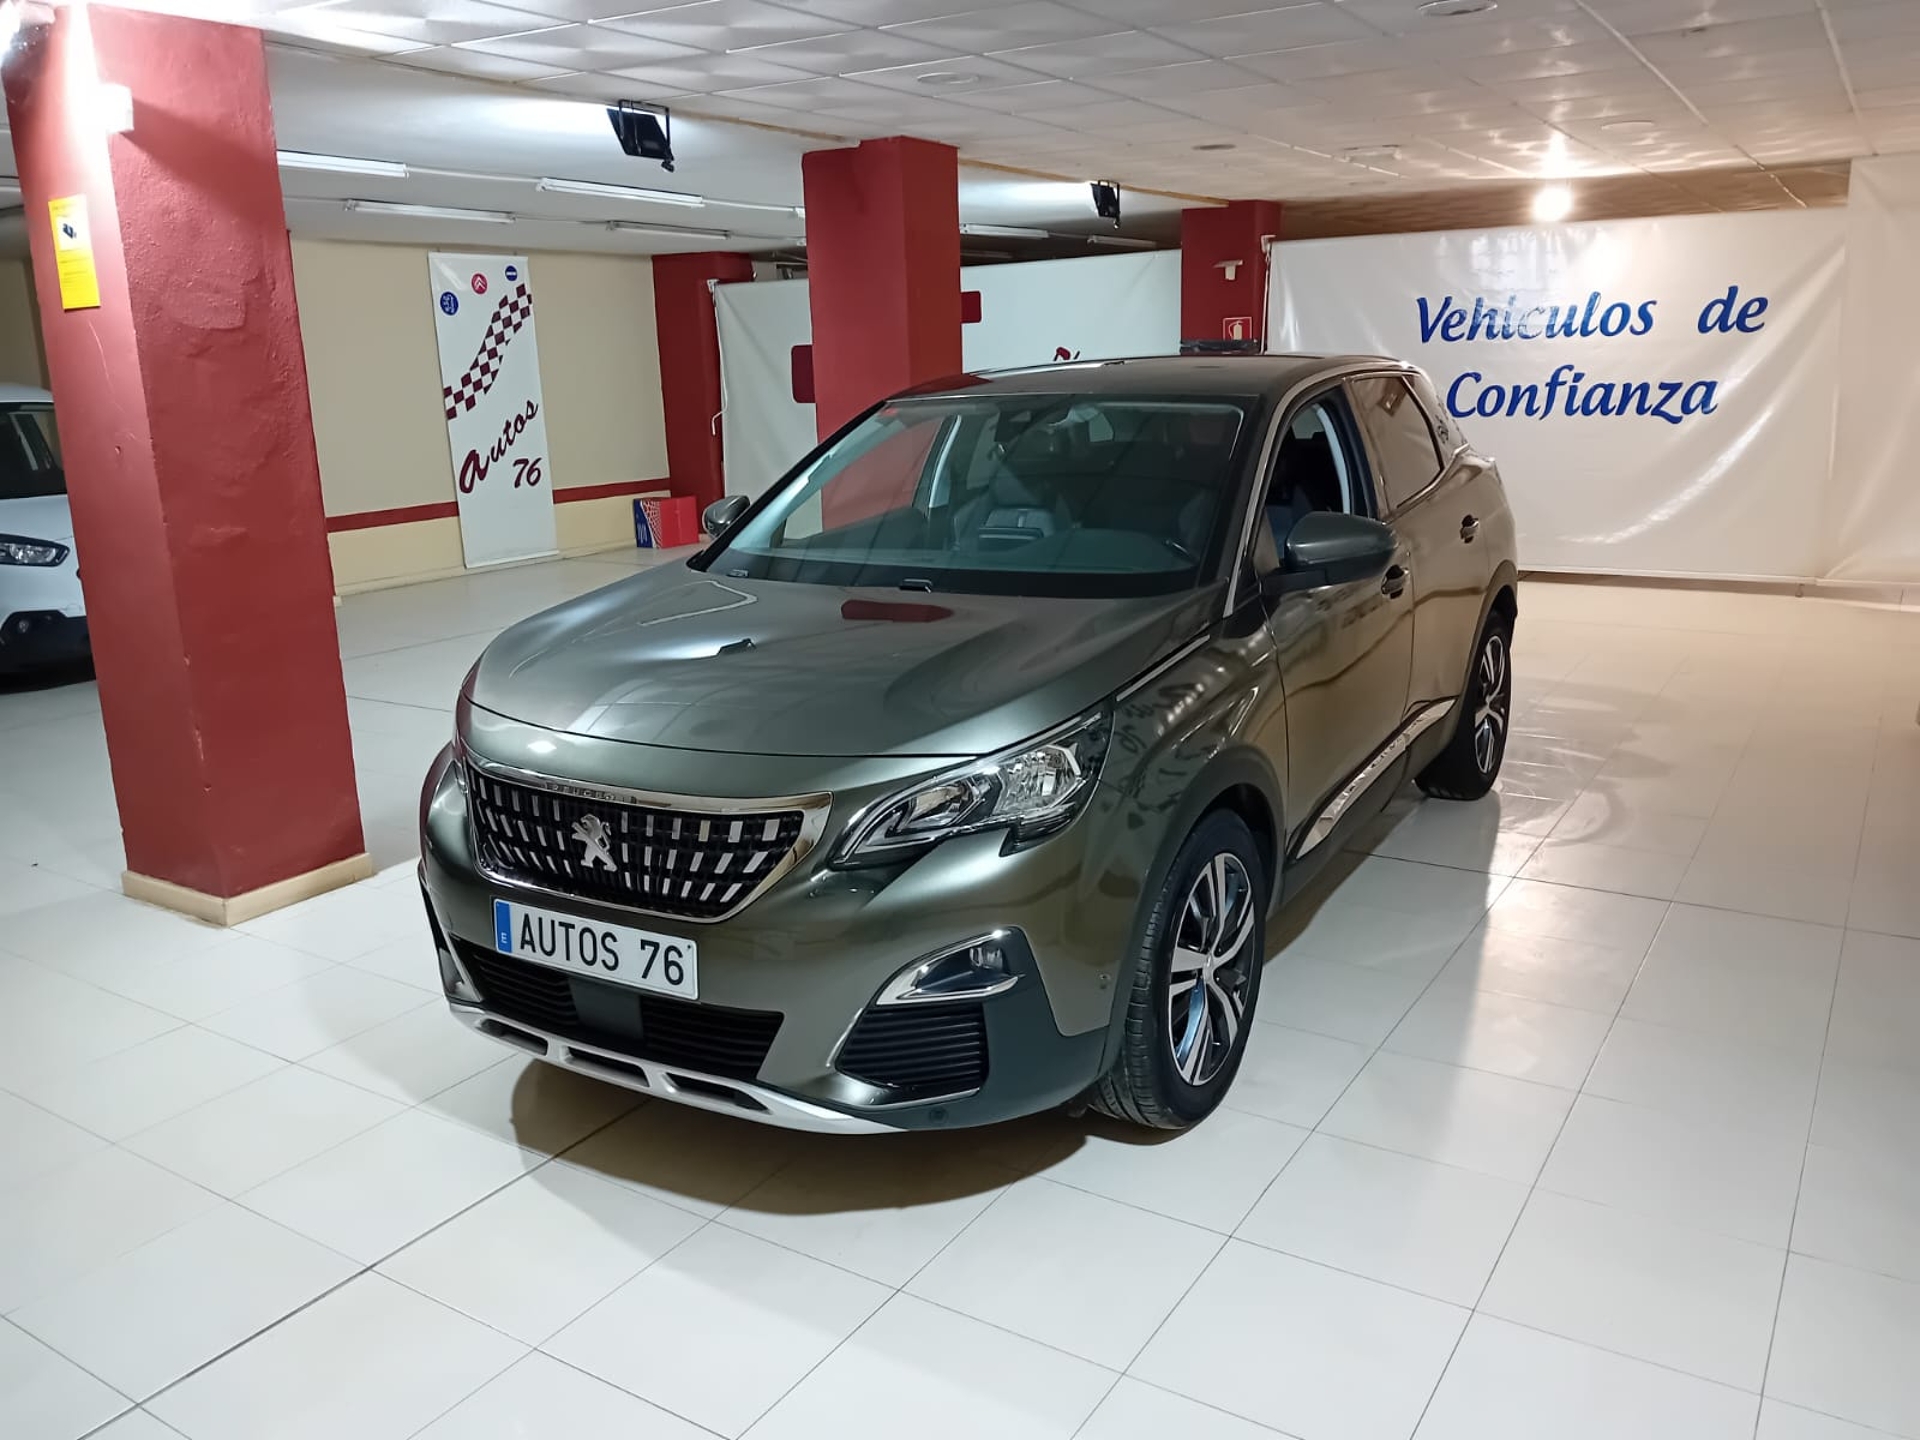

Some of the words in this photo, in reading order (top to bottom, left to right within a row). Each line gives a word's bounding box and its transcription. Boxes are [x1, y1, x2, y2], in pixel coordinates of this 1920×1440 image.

[1697, 285, 1769, 334] de
[1446, 364, 1719, 425] Confianza
[459, 399, 539, 494] Autos
[512, 457, 542, 489] 76
[501, 932, 508, 944] E
[520, 913, 619, 971] AUTOS
[640, 938, 684, 985] 76
